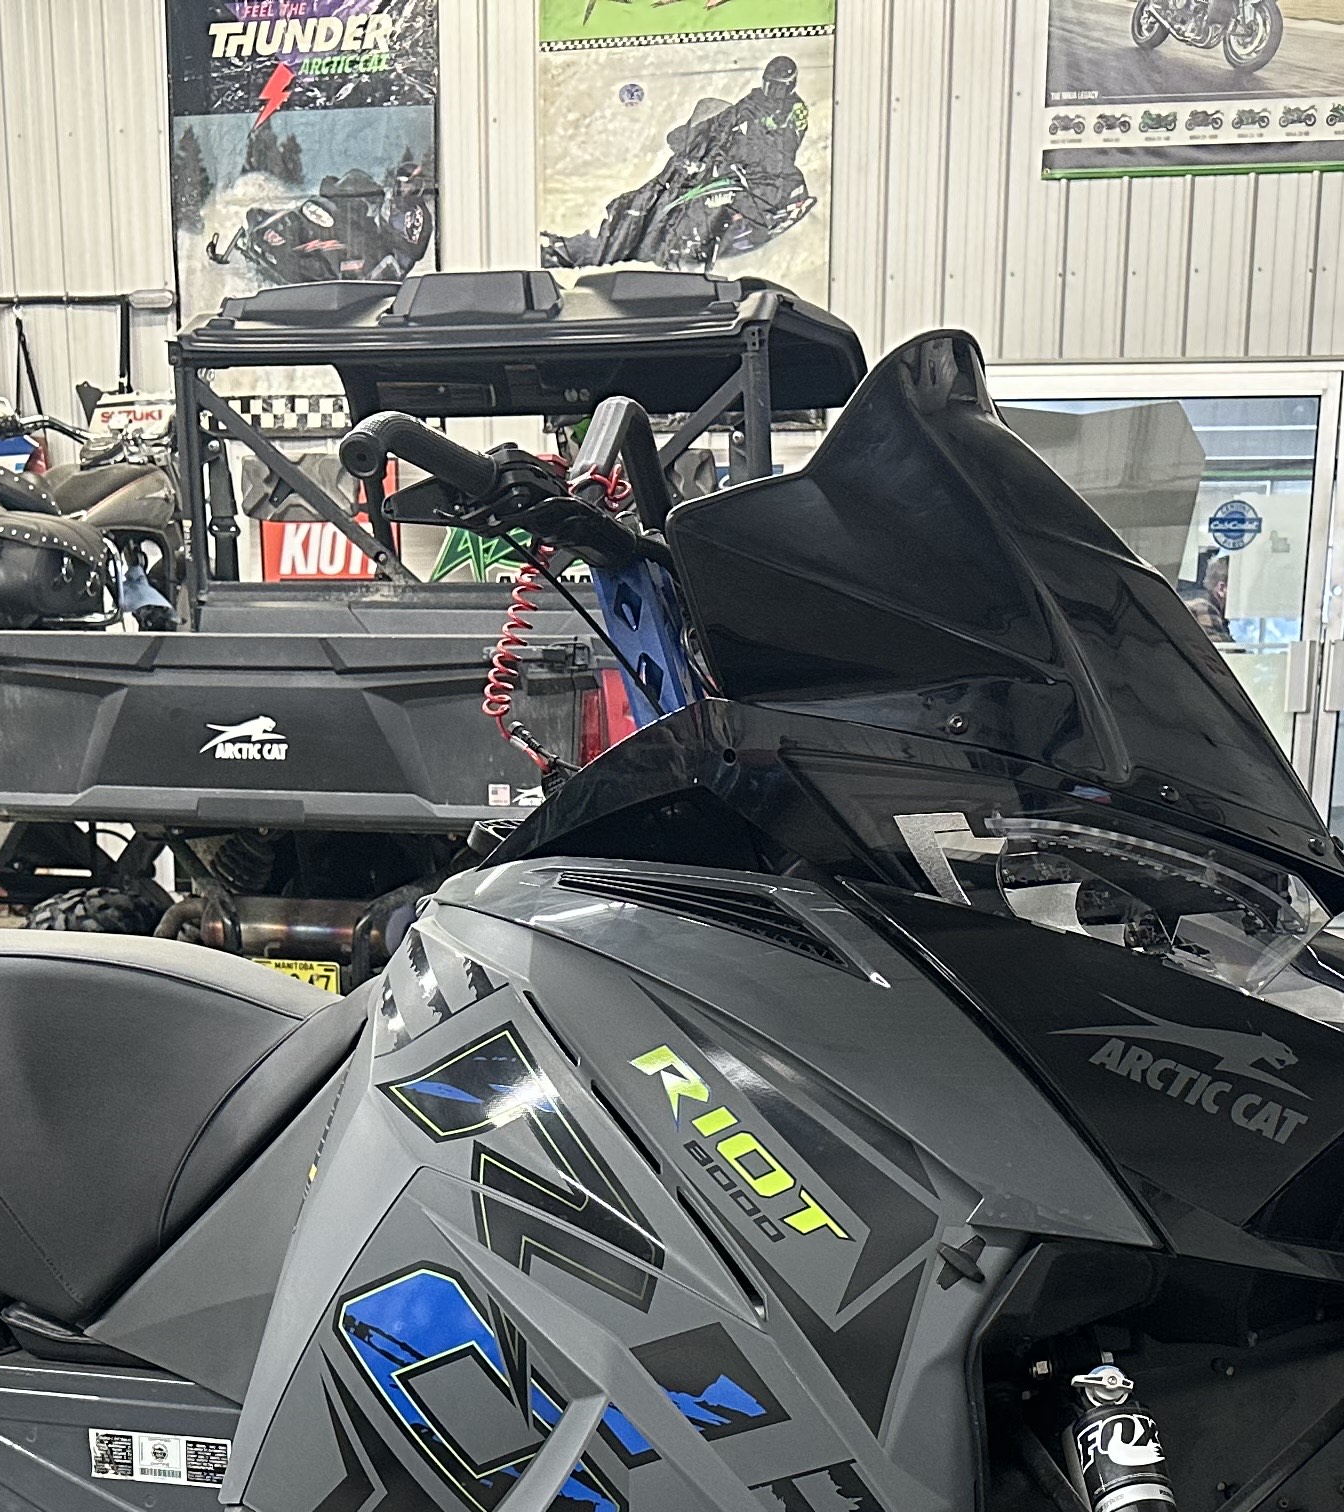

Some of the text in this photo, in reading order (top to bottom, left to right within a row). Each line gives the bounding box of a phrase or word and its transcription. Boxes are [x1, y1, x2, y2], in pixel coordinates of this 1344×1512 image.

[243, 2, 306, 19] FEEL THE
[209, 13, 392, 58] THUNDER
[298, 53, 389, 76] ARCTIC CAT
[101, 409, 163, 423] SZUKI
[215, 742, 289, 760] ARCTIC CAT
[275, 962, 314, 971] MANITOBA
[1088, 1038, 1309, 1144] ARCTIC CAT
[626, 1044, 856, 1242] RIOT
[1077, 1413, 1164, 1475] FOX
